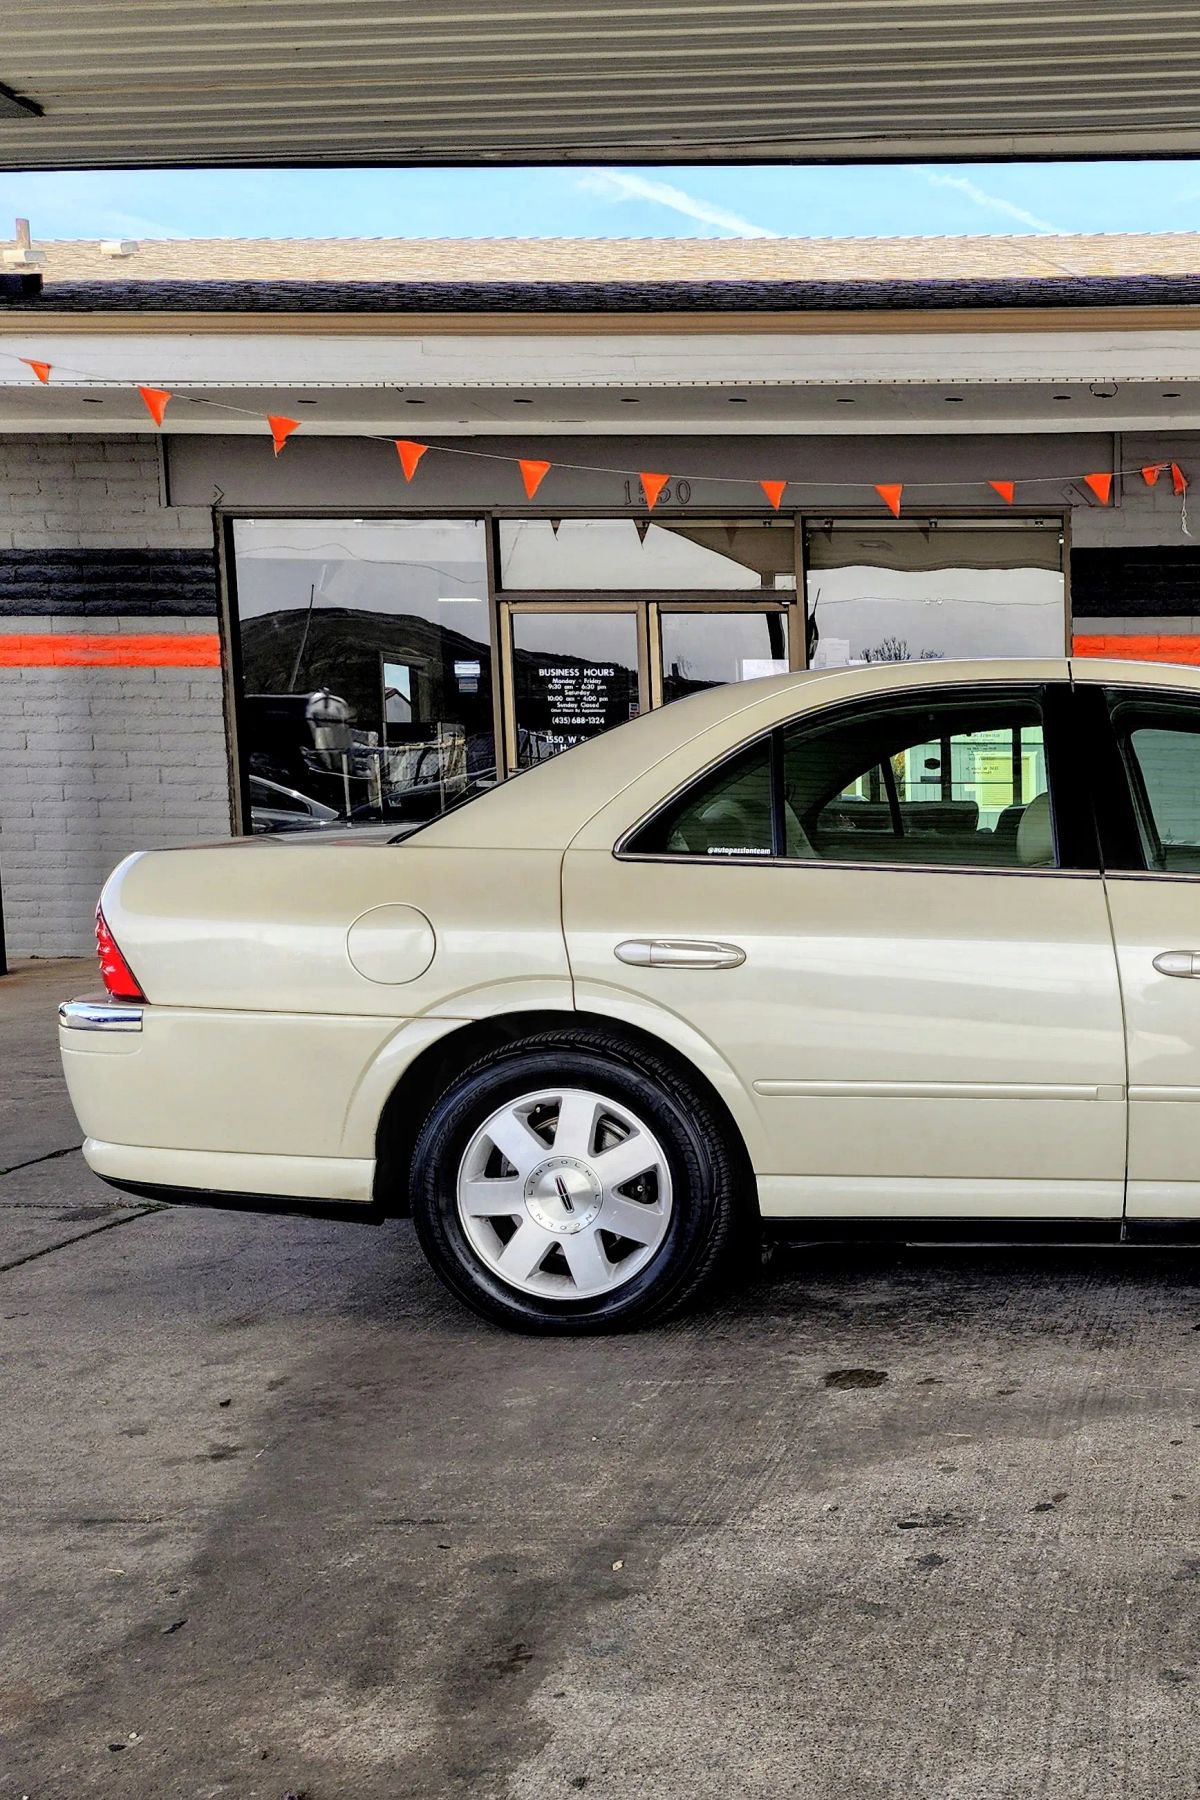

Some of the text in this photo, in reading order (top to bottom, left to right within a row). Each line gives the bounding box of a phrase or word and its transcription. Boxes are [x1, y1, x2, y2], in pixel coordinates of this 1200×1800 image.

[539, 668, 615, 677] BUSINESS HOURS
[552, 677, 577, 685] Monday
[545, 735, 564, 744] 1550
[567, 735, 577, 744] W
[527, 1158, 593, 1197] LINCOLN
